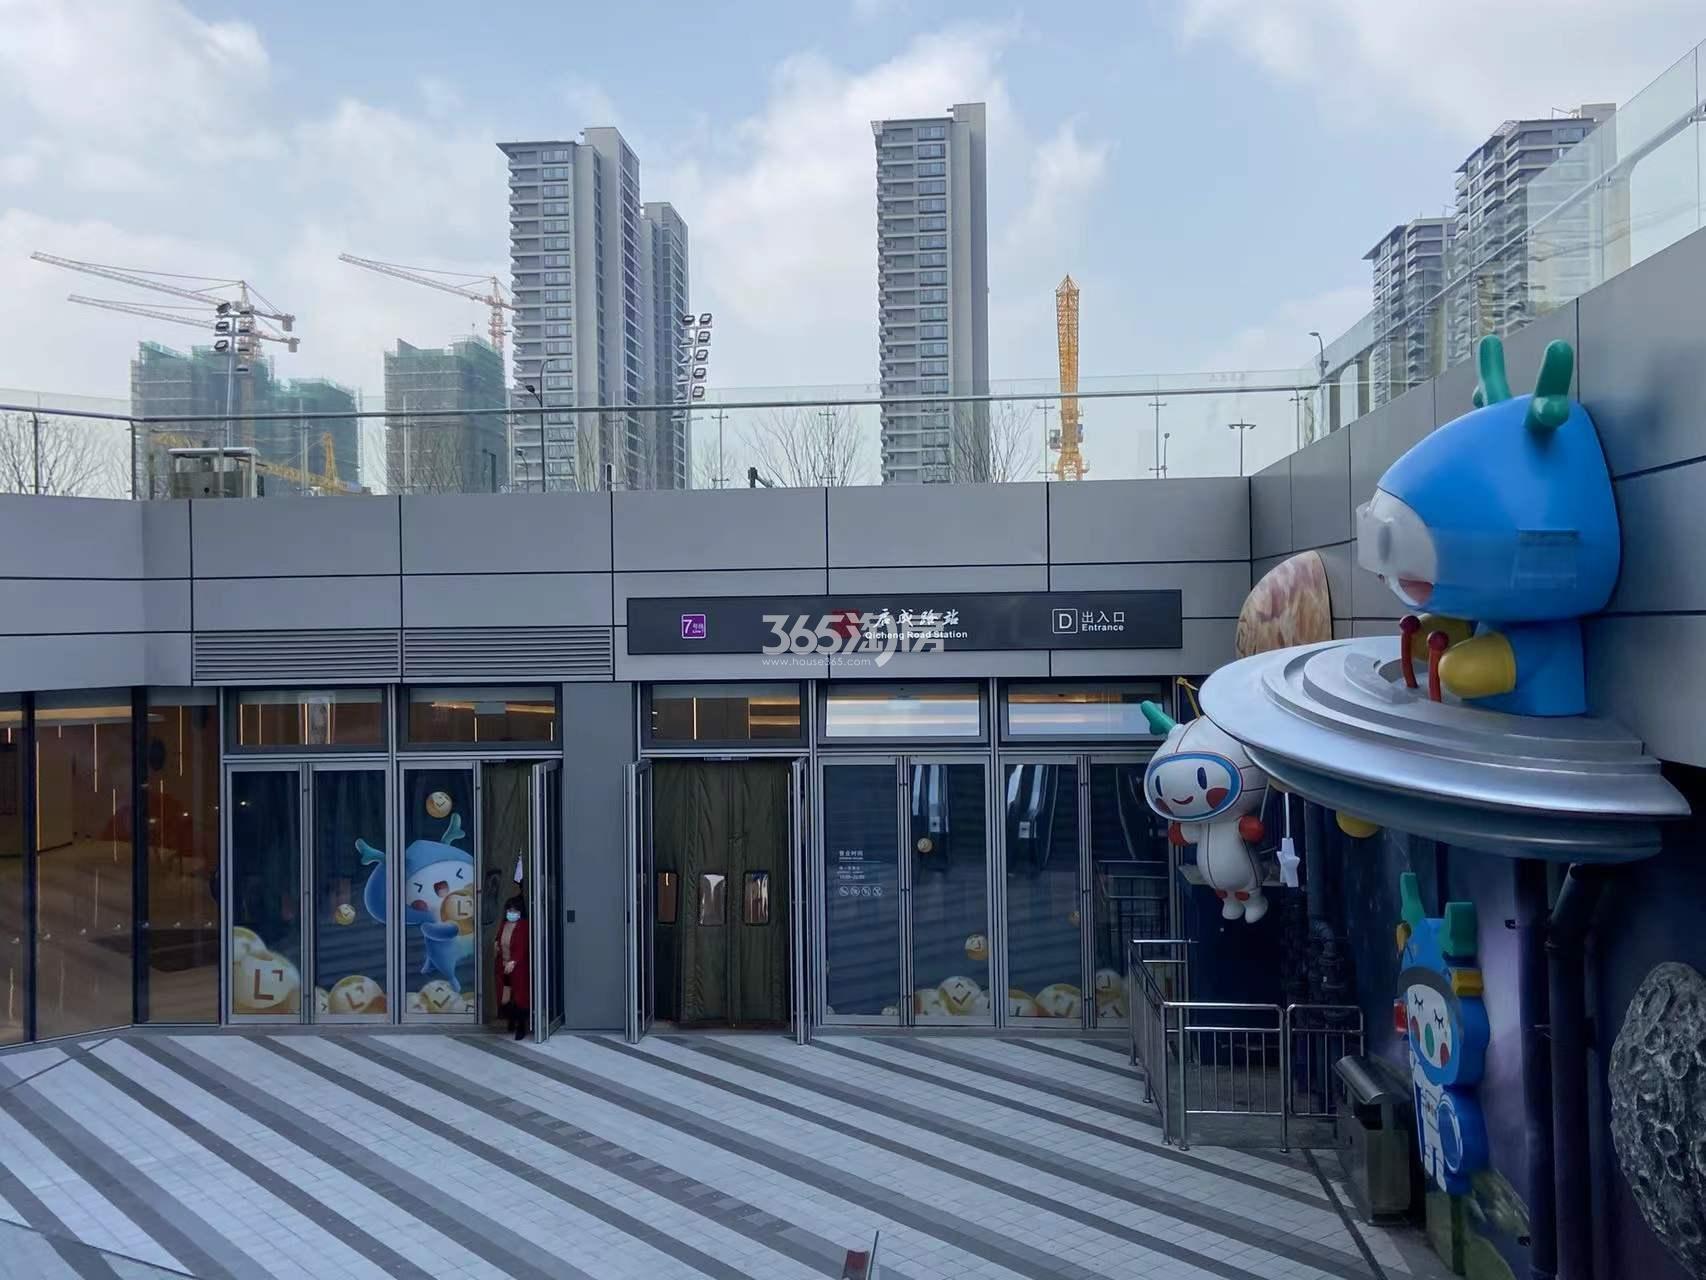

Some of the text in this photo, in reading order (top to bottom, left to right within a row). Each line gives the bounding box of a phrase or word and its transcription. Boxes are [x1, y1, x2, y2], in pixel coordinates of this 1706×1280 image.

[1058, 613, 1073, 629] D
[1082, 610, 1125, 623] 出入口
[682, 619, 693, 634] 7
[1081, 623, 1124, 632] Entrance
[864, 630, 968, 641] Qicheng Road Station
